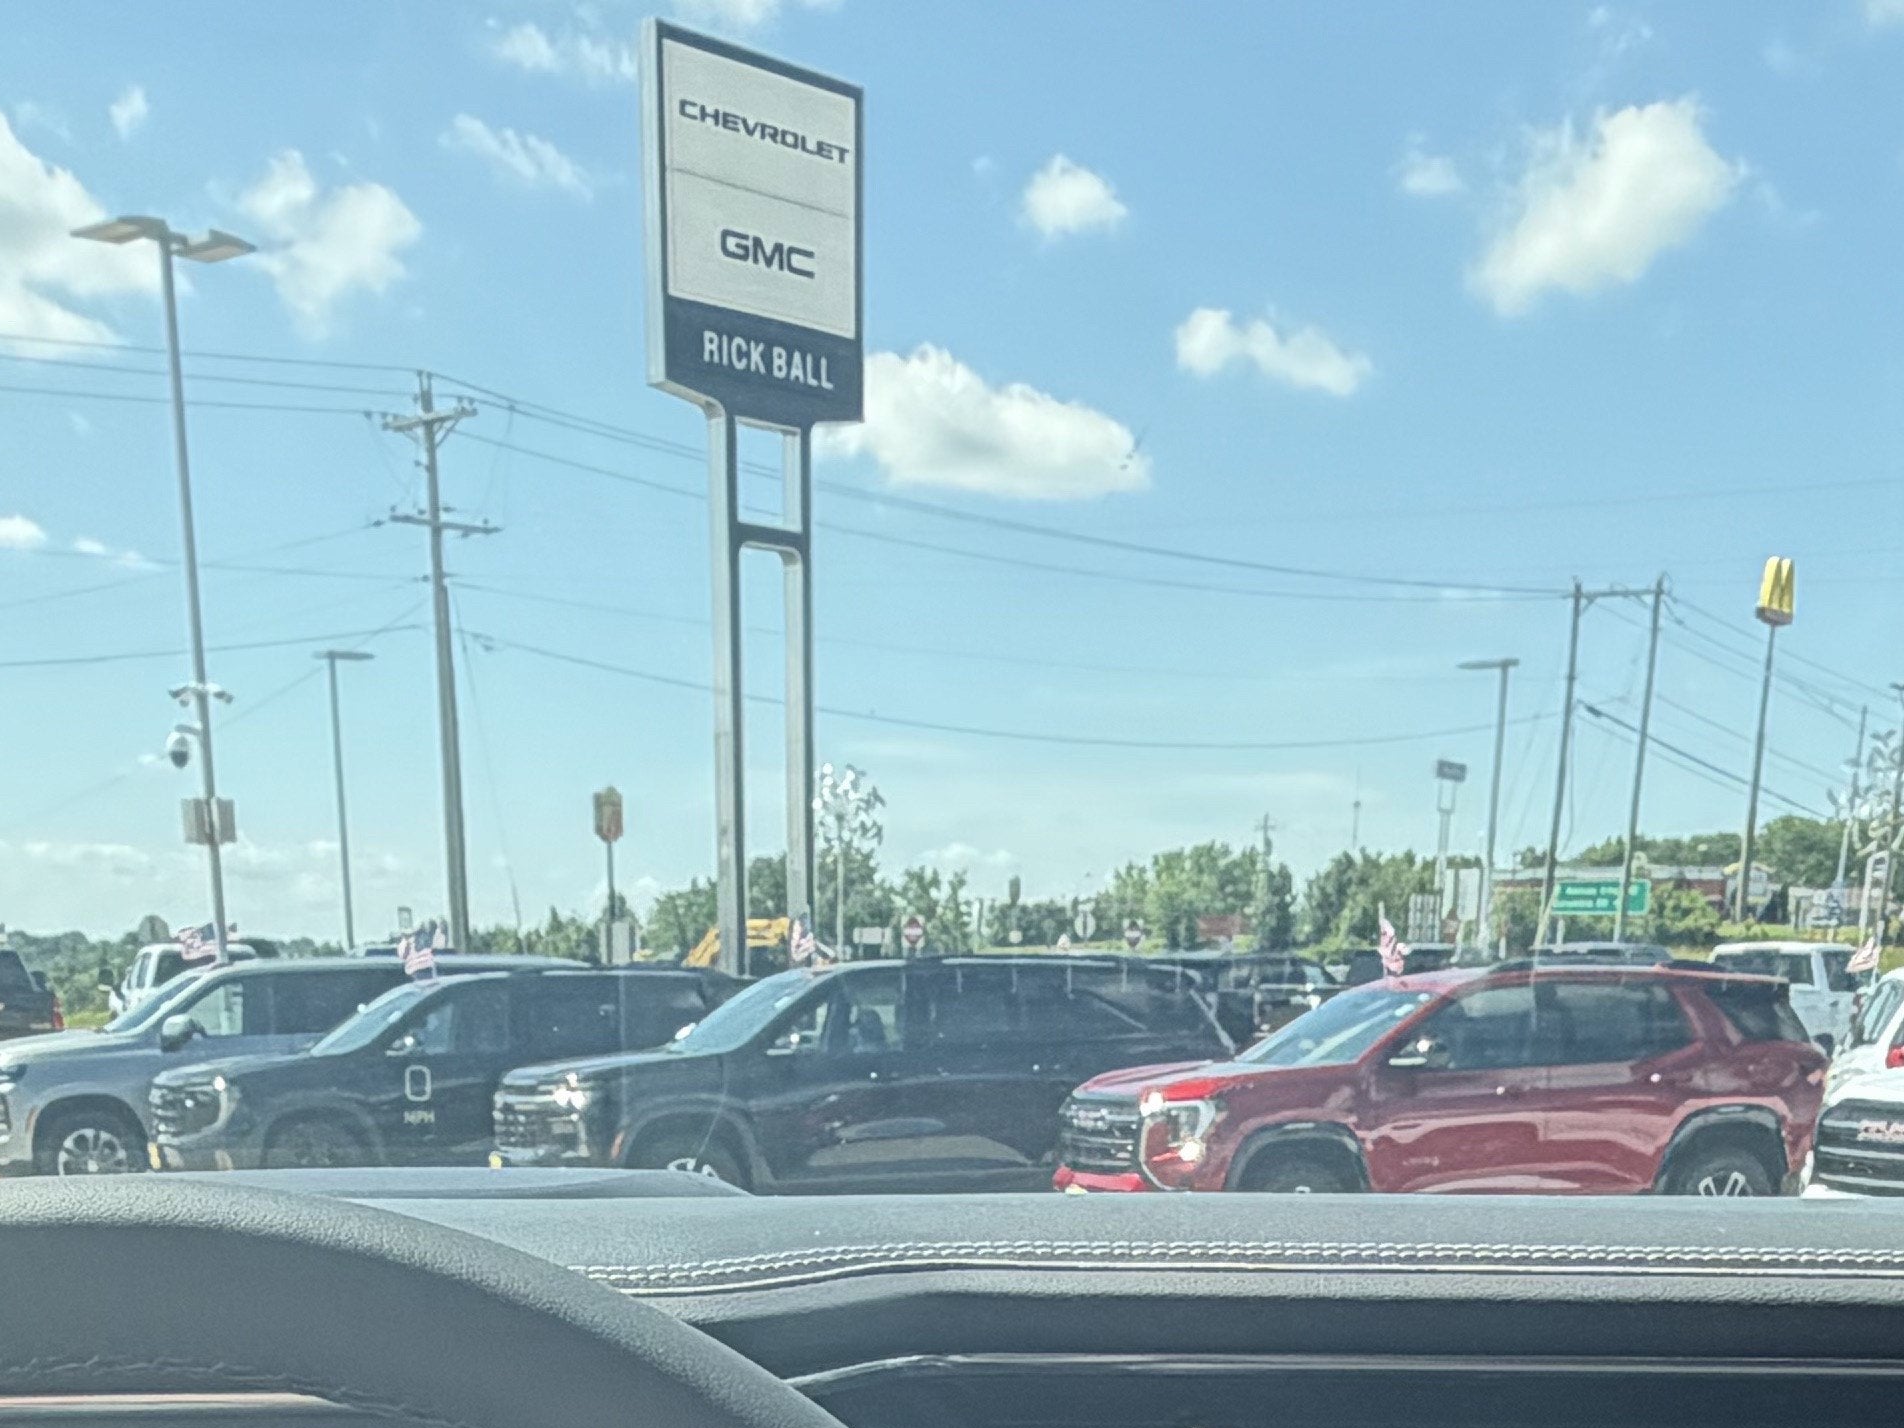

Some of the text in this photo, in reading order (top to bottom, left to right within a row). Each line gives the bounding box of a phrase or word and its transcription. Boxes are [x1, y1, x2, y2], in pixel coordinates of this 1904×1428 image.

[678, 98, 850, 165] CHEVROLET
[720, 227, 816, 280] GMC
[702, 330, 834, 391] RICK BALL
